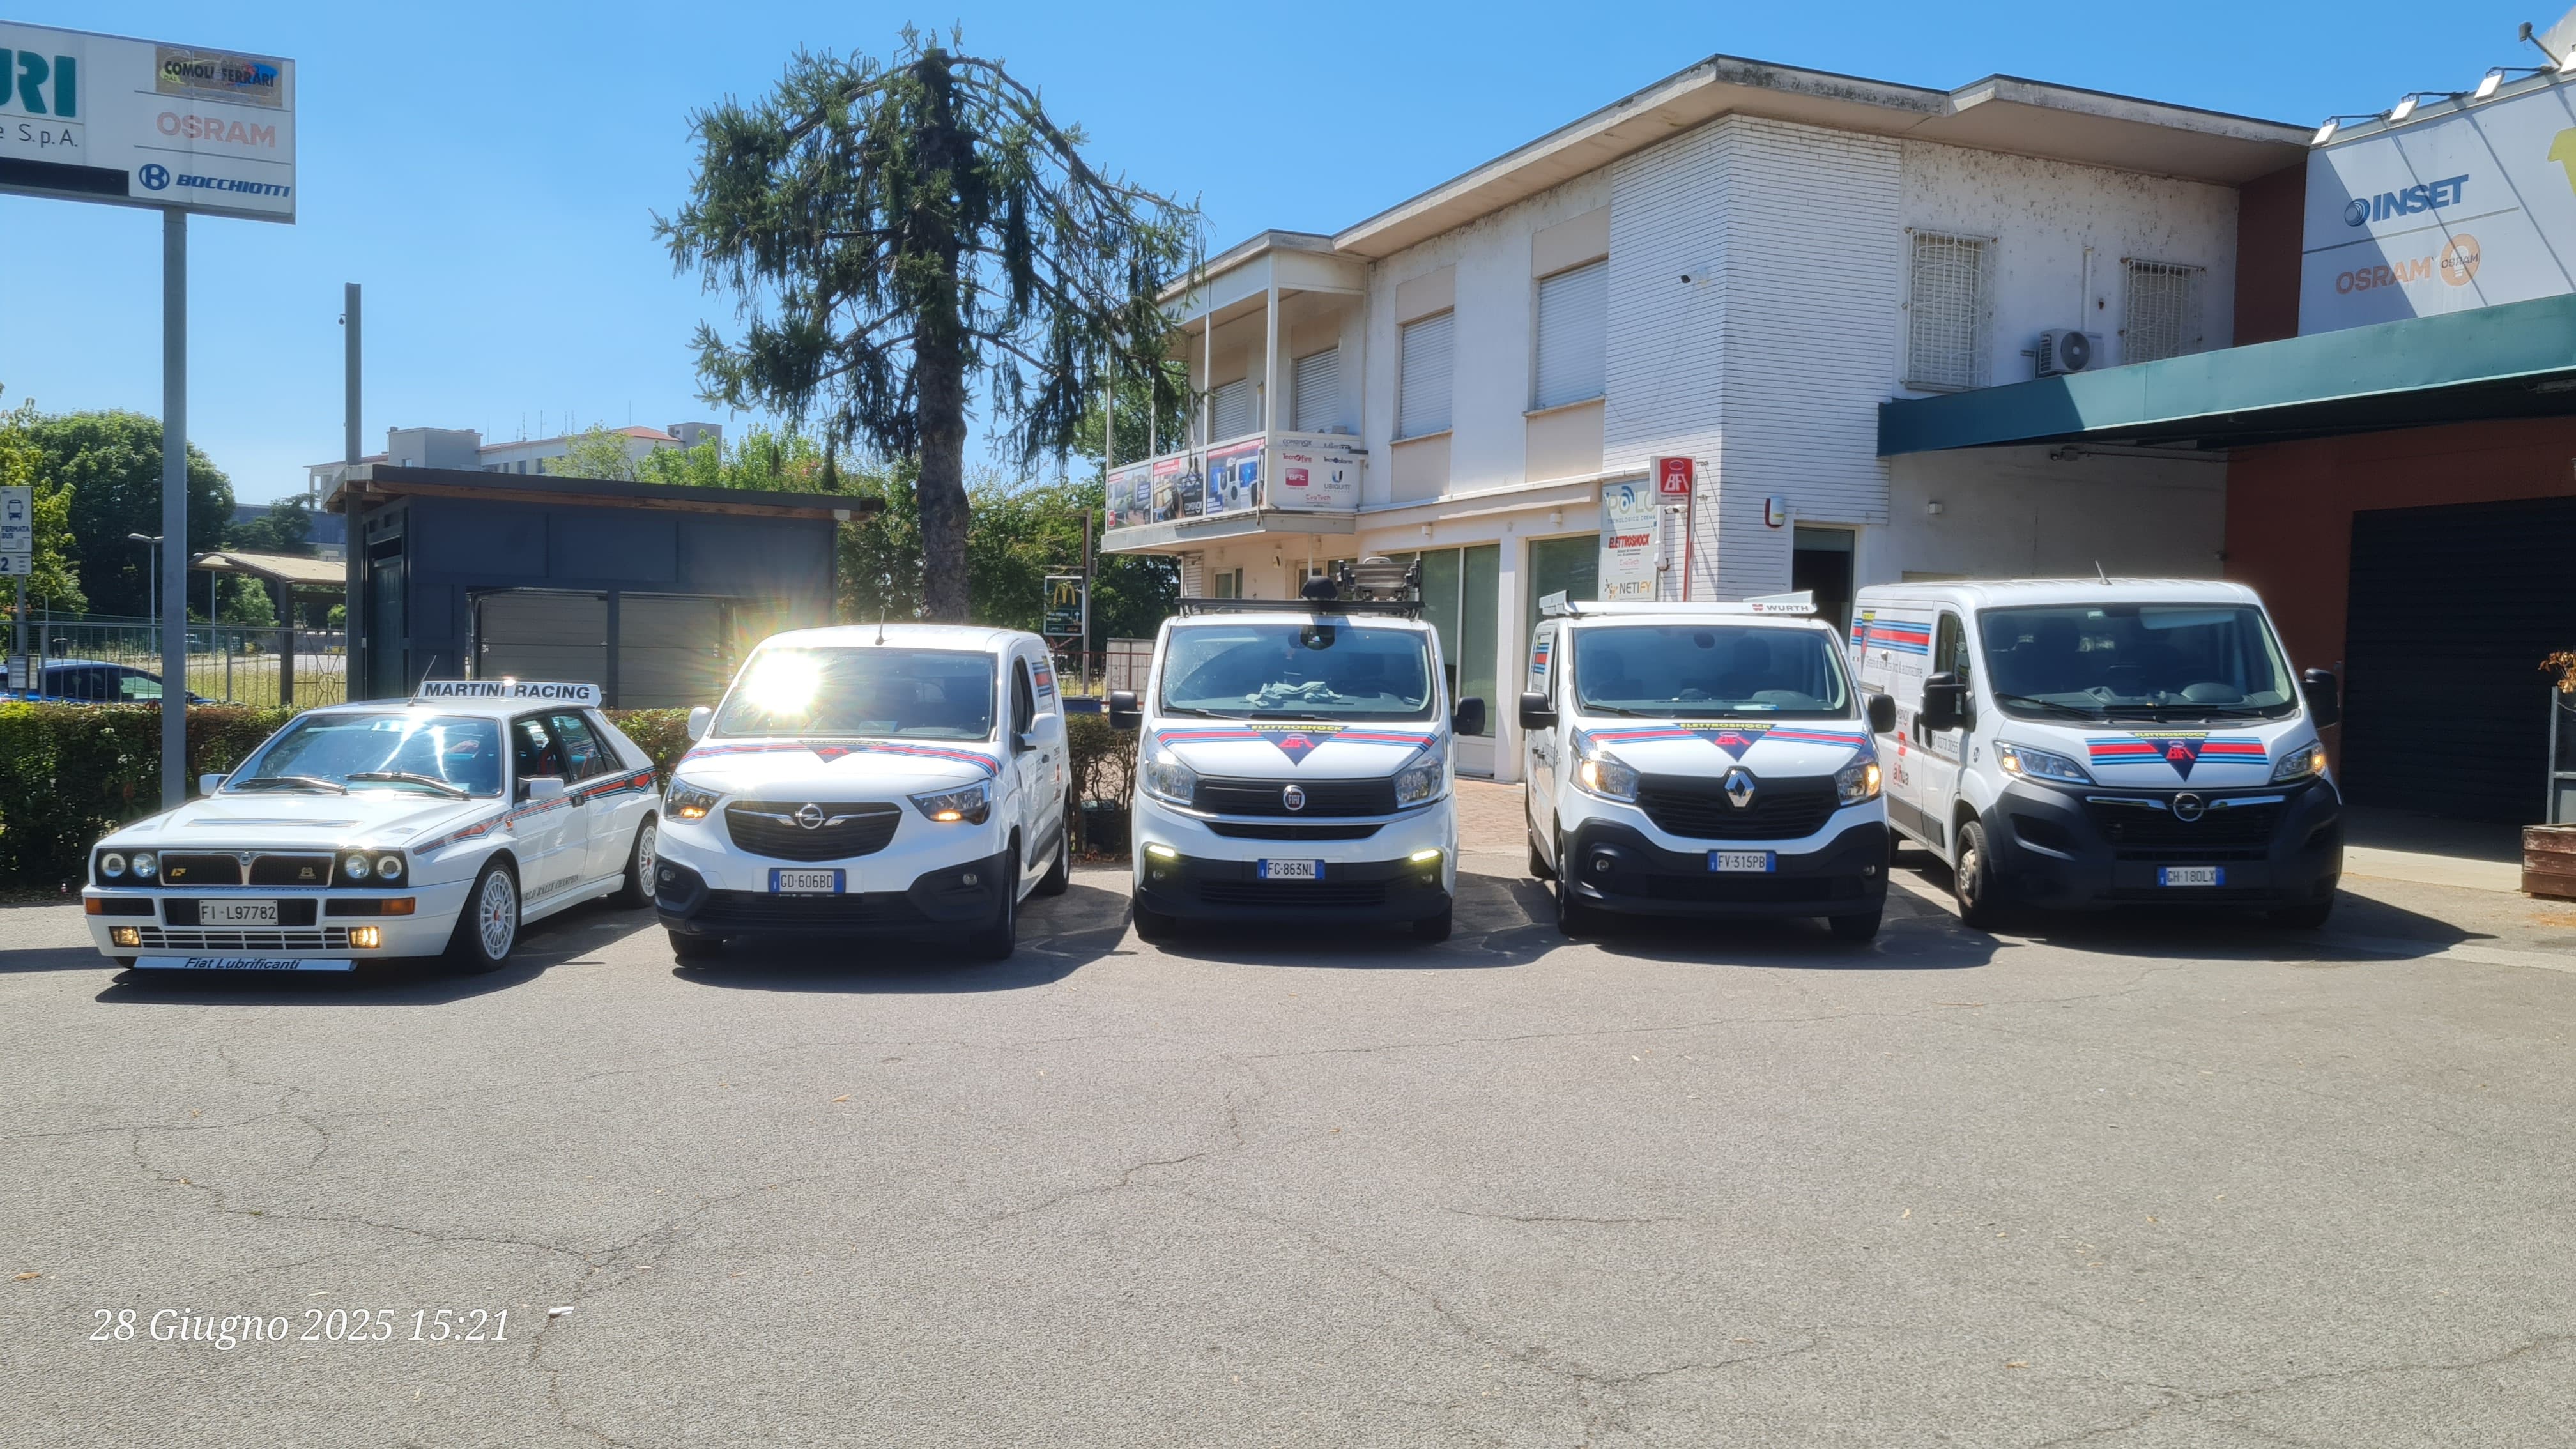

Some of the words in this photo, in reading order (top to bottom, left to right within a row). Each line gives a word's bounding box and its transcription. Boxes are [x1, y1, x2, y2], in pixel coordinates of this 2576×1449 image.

[164, 61, 215, 79] COMOLI
[222, 68, 274, 87] FERRARI
[19, 123, 78, 148] S.p.A.
[157, 112, 275, 148] OSRAM
[176, 174, 291, 197] BOCCHIOTTI
[2372, 174, 2469, 222] INSET
[2441, 253, 2479, 269] OSRAM
[2336, 256, 2432, 295] OSRAM
[1620, 581, 1652, 594] NETIFY
[425, 684, 505, 696] MARTINI
[514, 684, 590, 699] RACING
[1288, 794, 1301, 804] FIAT
[185, 957, 213, 969] Fiat
[217, 957, 302, 969] Lubrificanti
